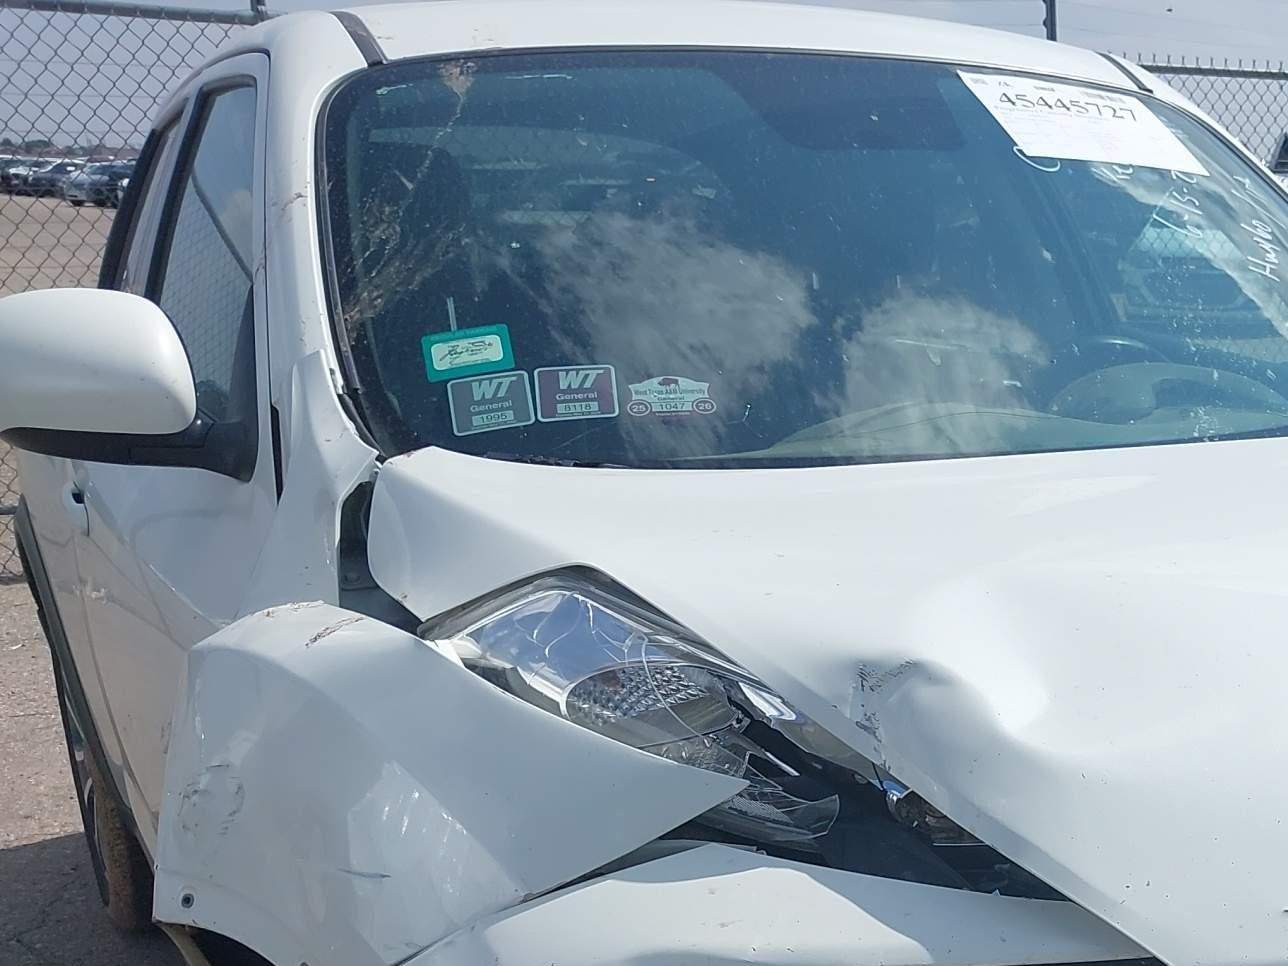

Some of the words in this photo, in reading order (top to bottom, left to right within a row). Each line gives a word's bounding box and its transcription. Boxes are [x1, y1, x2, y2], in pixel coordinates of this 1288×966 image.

[998, 91, 1137, 122] 45445727
[557, 369, 604, 390] WT
[471, 376, 517, 401] WT
[555, 391, 598, 401] General
[469, 399, 513, 413] General
[659, 402, 686, 410] 1047
[479, 412, 508, 424] 1995
